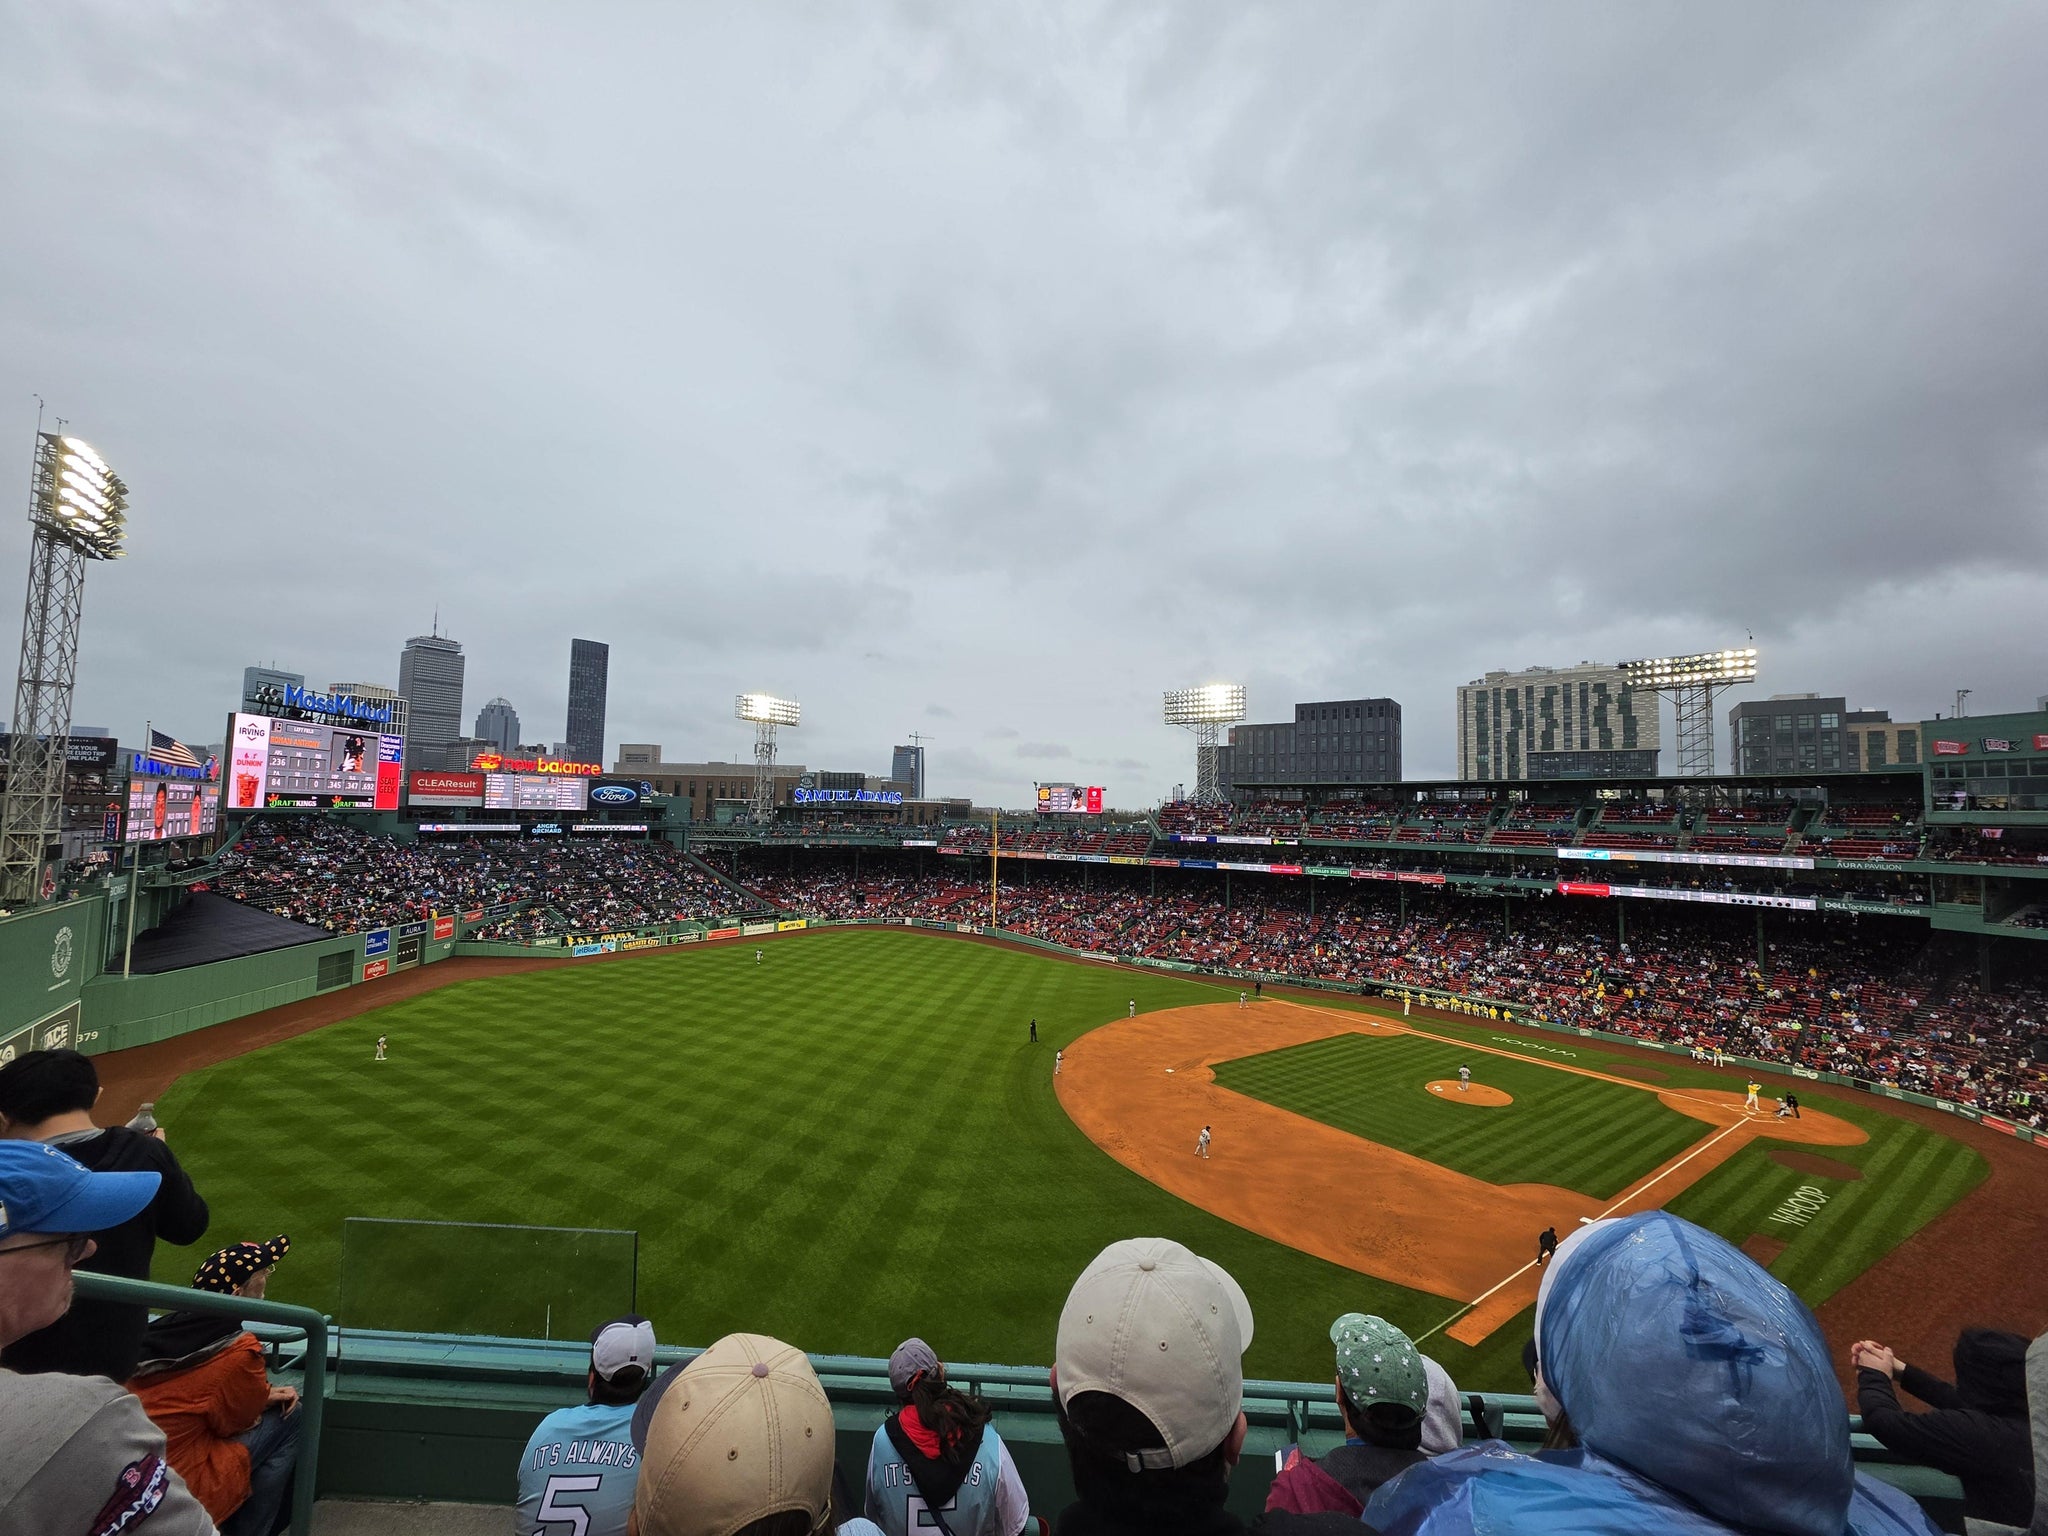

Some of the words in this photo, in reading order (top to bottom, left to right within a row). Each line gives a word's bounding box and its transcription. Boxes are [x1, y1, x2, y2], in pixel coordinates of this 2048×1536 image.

[283, 683, 393, 723] MassMutual
[239, 727, 265, 737] IRVING
[537, 758, 602, 775] balance
[345, 782, 358, 790] .347
[380, 777, 395, 785] SEAT
[417, 778, 477, 788] CLEAResult
[379, 786, 396, 794] GEEK
[600, 788, 628, 801] Ford
[794, 788, 853, 803] SAMUEL
[853, 789, 903, 805] ADAMS
[269, 800, 317, 808] DRAFTKINGS
[333, 801, 373, 809] DRAFTKINGS
[1848, 903, 1897, 914] Technologies
[405, 926, 421, 934] AURA
[679, 932, 699, 941] wasabi
[575, 945, 598, 956] jetBlue
[367, 965, 385, 974] IRVING
[76, 1031, 98, 1043] 379
[1768, 1186, 1831, 1227] WHOOP
[564, 1440, 637, 1469] ALWAYS
[536, 1473, 603, 1536] 5
